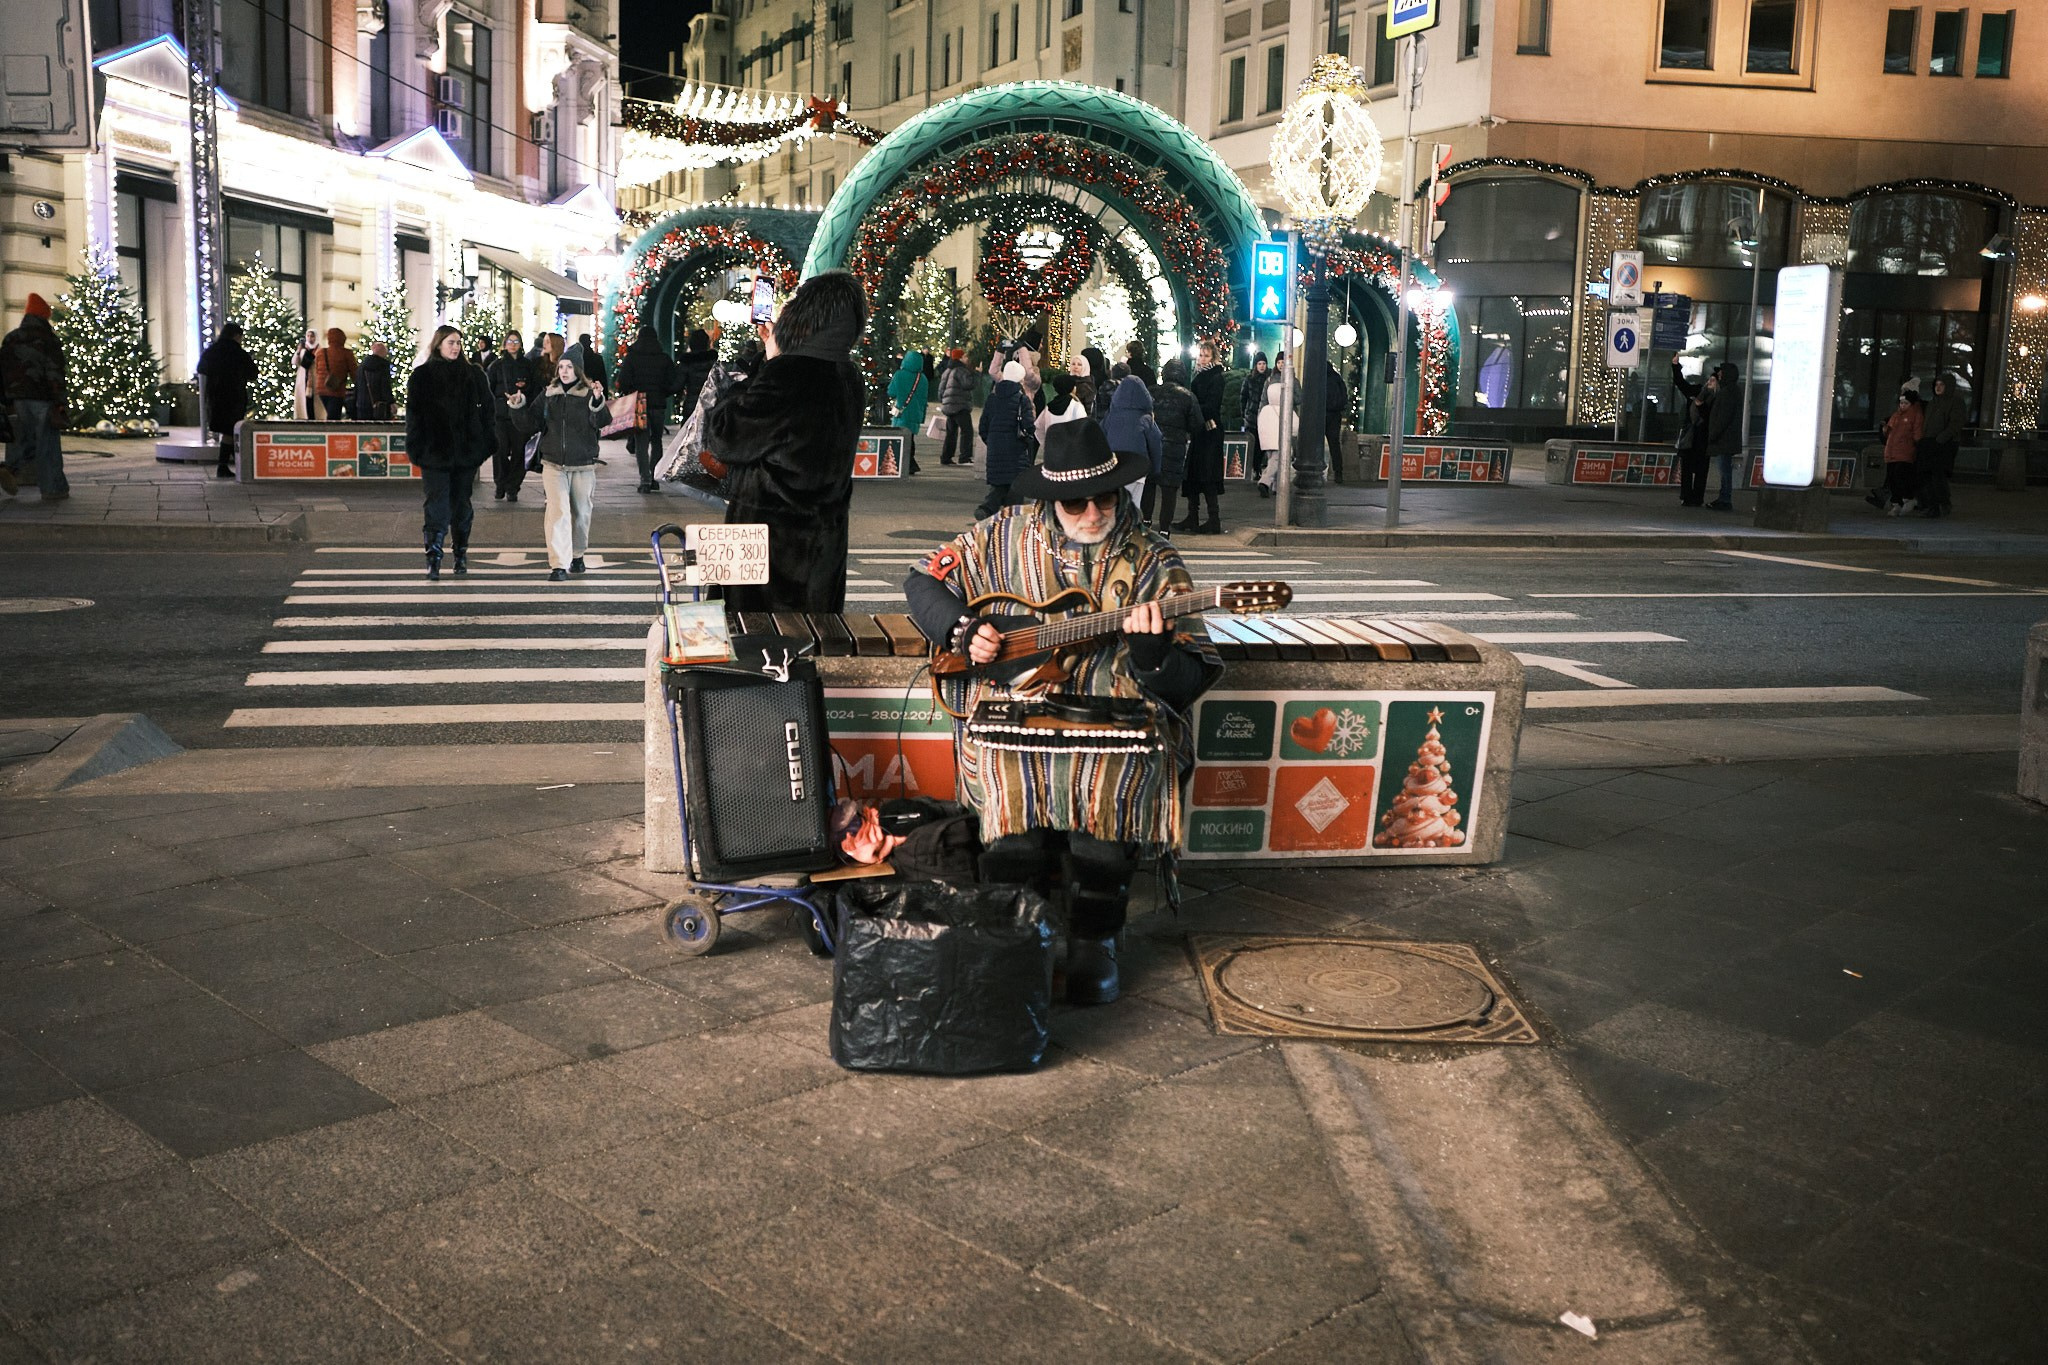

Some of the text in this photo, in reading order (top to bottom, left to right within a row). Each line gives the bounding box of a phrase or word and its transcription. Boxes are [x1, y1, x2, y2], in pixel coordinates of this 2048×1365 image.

[268, 449, 315, 460] ЗИМА
[1402, 457, 1417, 466] МА
[1582, 462, 1606, 470] ЗИМА
[698, 527, 767, 541] СБЕРБАНК
[699, 543, 767, 561] 4276 3800
[700, 562, 766, 582] 3206 1967
[785, 722, 806, 801] CUBE
[1200, 822, 1254, 835] МОСКИНО
